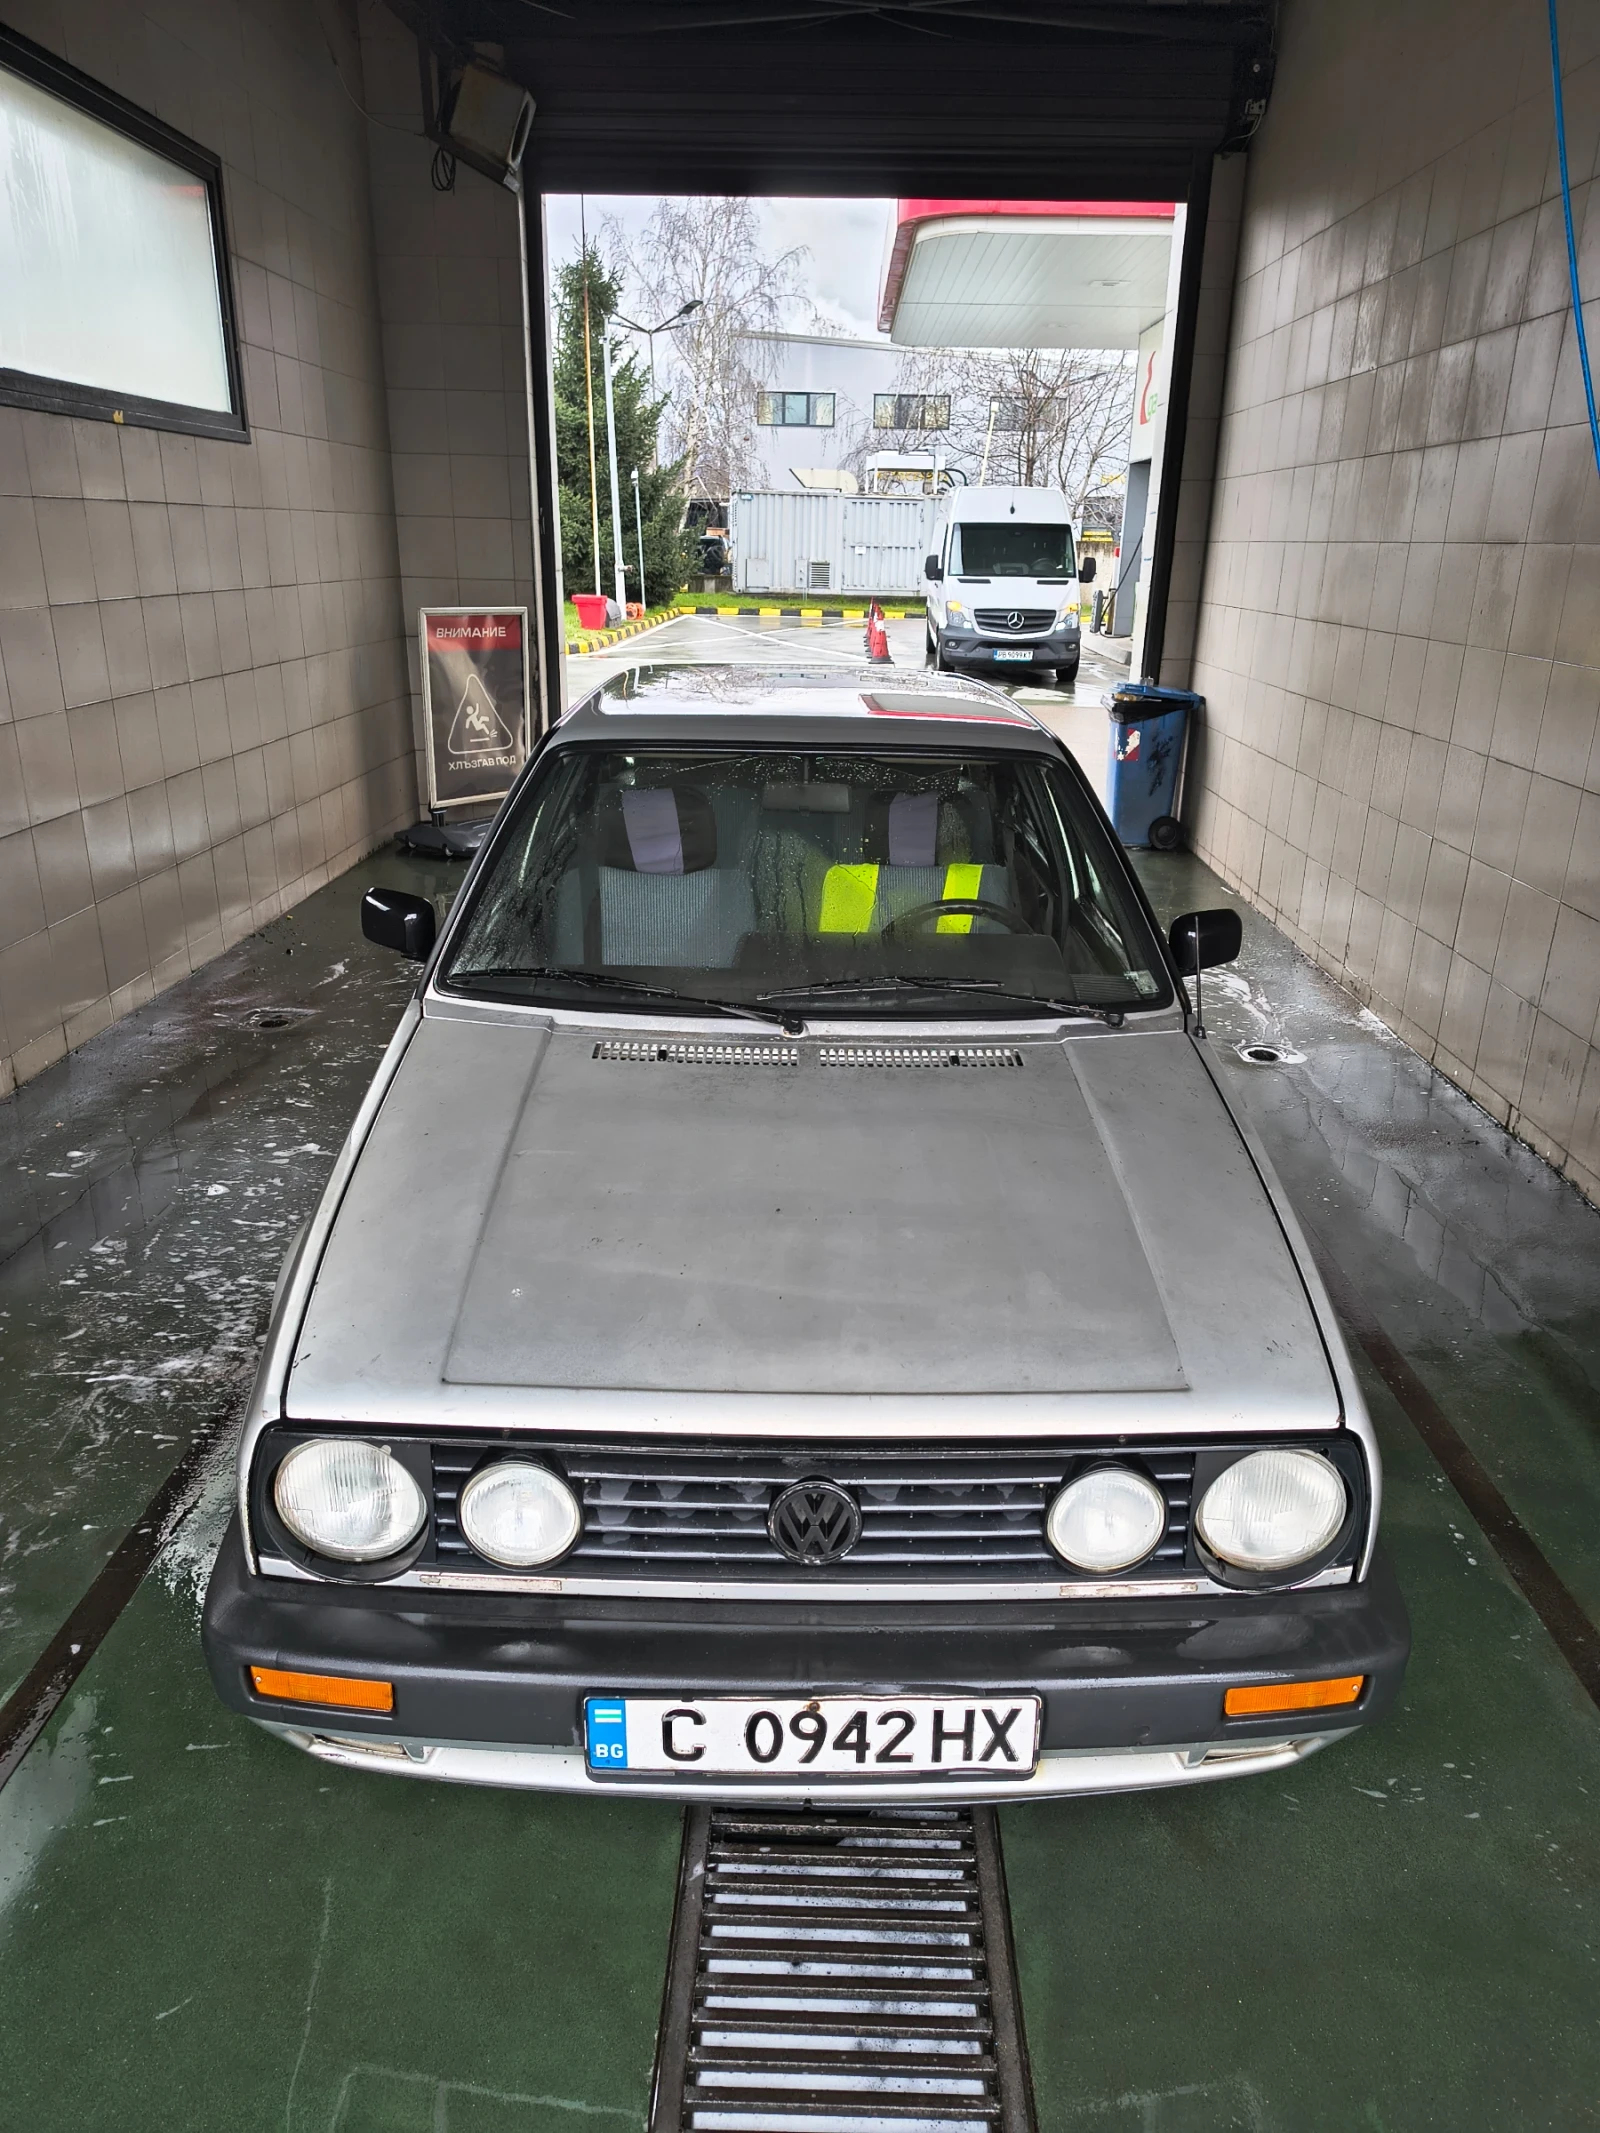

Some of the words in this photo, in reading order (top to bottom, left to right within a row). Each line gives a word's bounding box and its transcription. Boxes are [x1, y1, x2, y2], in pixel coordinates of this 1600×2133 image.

[436, 627, 507, 638] ВНИМАНИЕ
[448, 758, 495, 771] ХЛЪЗГАВ
[496, 755, 516, 767] ПОД
[661, 1706, 707, 1763] C
[743, 1706, 916, 1765] 0942
[930, 1706, 1023, 1764] HX
[595, 1743, 624, 1759] BG
